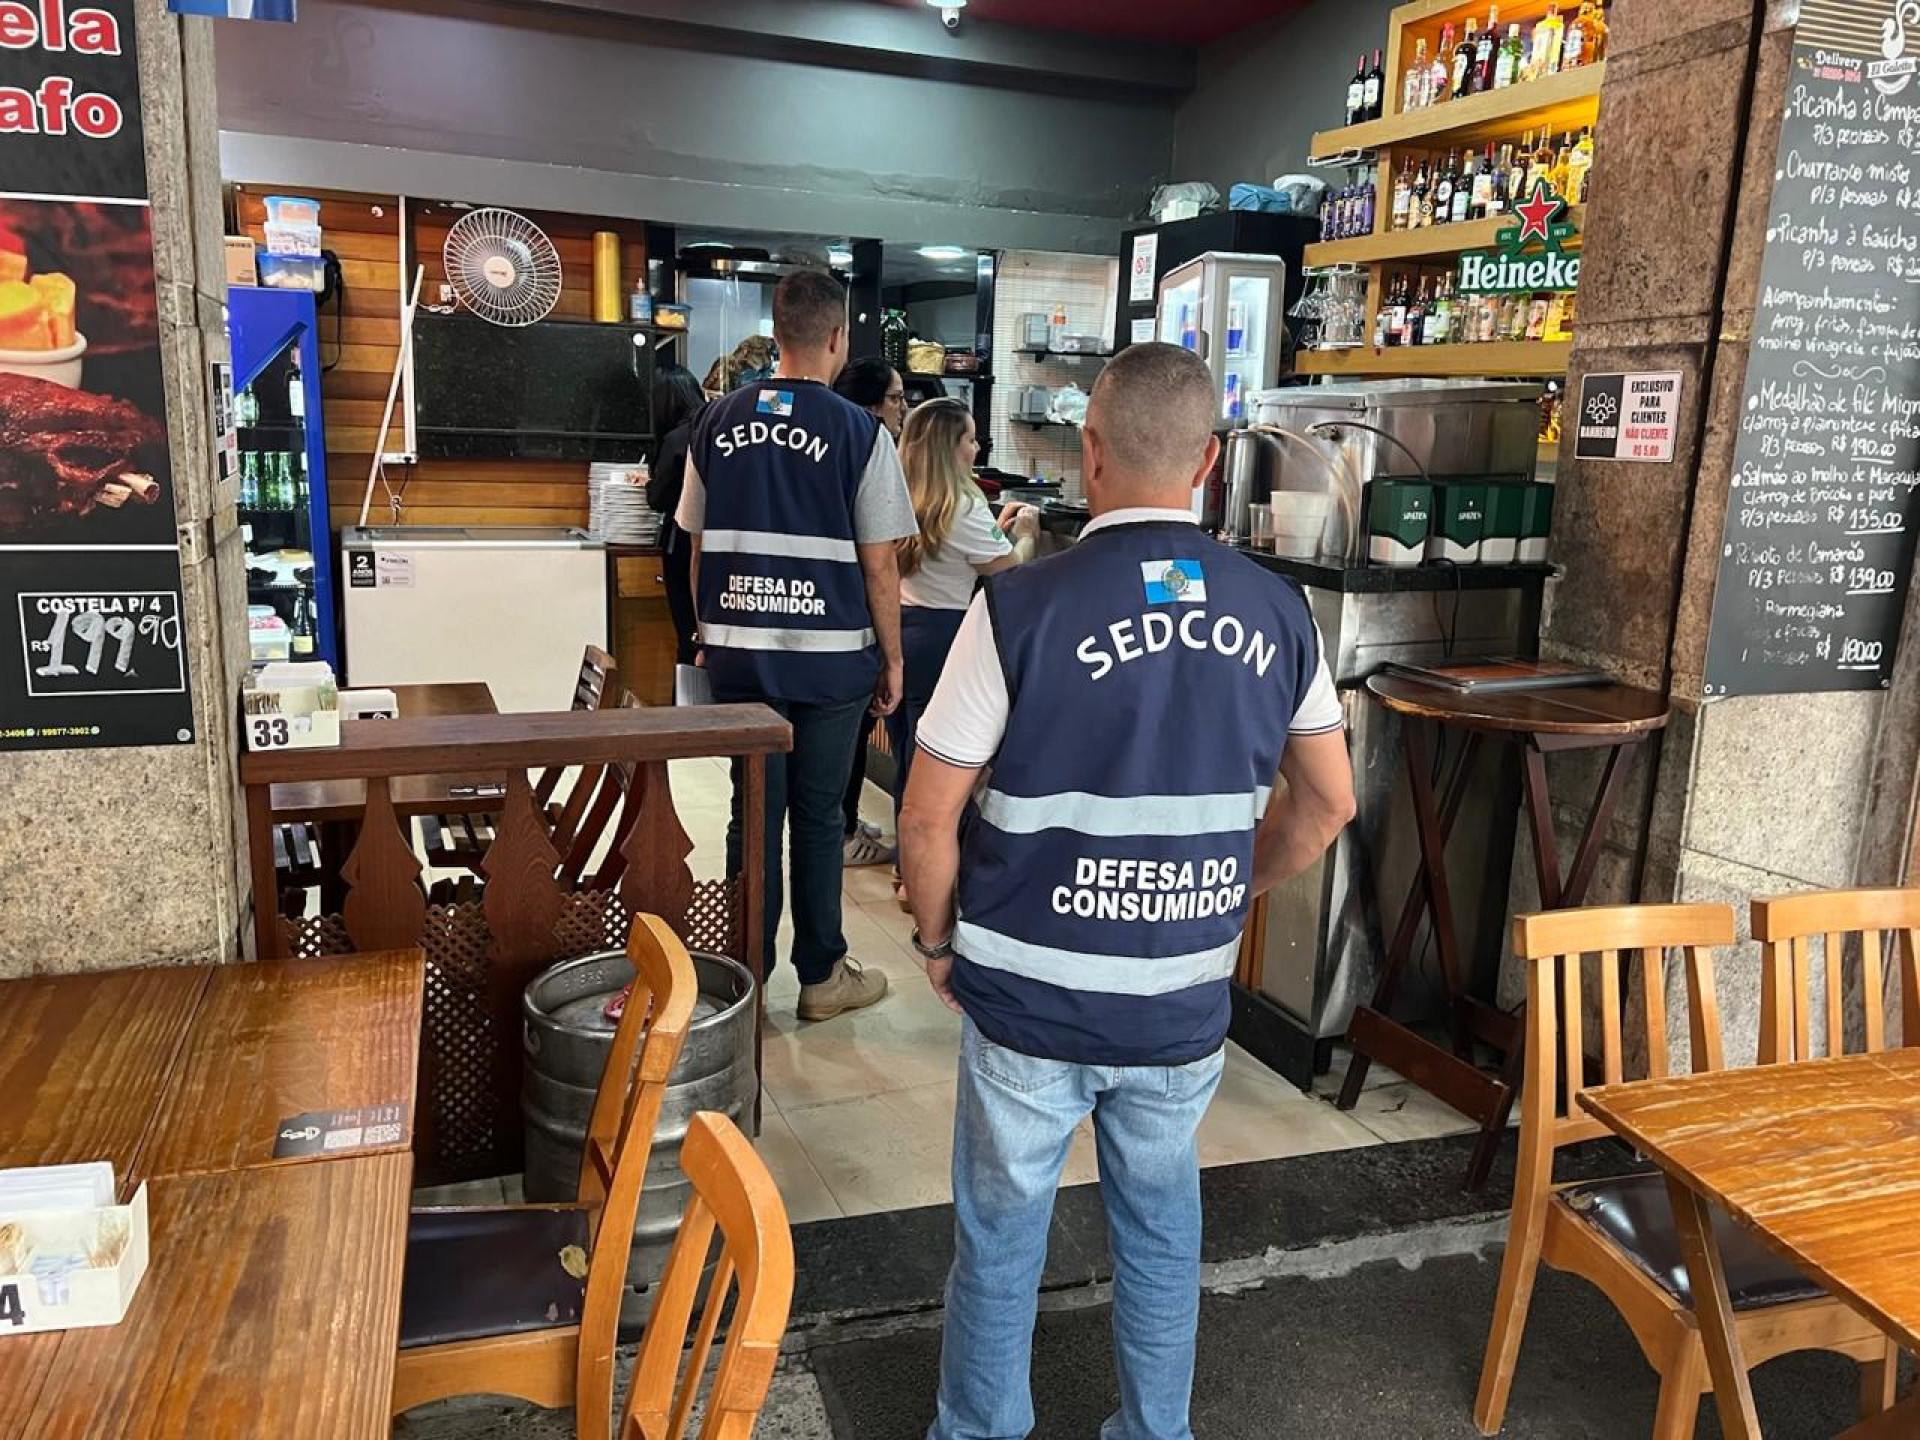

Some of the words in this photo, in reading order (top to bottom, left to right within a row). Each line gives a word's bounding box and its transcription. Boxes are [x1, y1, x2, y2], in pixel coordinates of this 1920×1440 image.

[0, 0, 120, 55] ela
[1815, 50, 1862, 71] Delivery
[0, 77, 123, 138] afo
[1792, 84, 1857, 119] Picanha
[1787, 150, 1863, 183] Churrasco
[1866, 161, 1911, 184] misto
[1777, 213, 1838, 244] Picanha
[1862, 223, 1917, 252] Gaúcha
[1459, 252, 1581, 290] Heineke
[1803, 248, 1825, 272] P/3
[1758, 336, 1801, 350] molho
[1631, 380, 1674, 394] EXCLUSIVO
[1639, 395, 1661, 409] PARA
[1631, 411, 1667, 424] CLIENTES
[715, 422, 828, 463] SEDCON
[1641, 428, 1669, 441] CLIENTE
[1742, 460, 1788, 486] Salmão
[1791, 470, 1807, 484] ao
[1740, 508, 1764, 528] P/3
[1827, 504, 1846, 524] R$
[1849, 508, 1903, 529] 135,00
[356, 555, 370, 569] 2
[728, 575, 787, 596] DEFESA
[790, 579, 815, 598] DO
[1749, 567, 1774, 589] P/3
[37, 598, 124, 614] COSTELA
[150, 597, 161, 612] 4
[720, 592, 826, 616] CONSUMIDOR
[1076, 609, 1277, 681] SEDCON
[254, 718, 289, 747] 33
[1075, 857, 1195, 890] DEFESA
[1201, 856, 1238, 888] DO
[1052, 884, 1246, 923] CONSUMIDOR
[0, 1283, 26, 1326] 4
